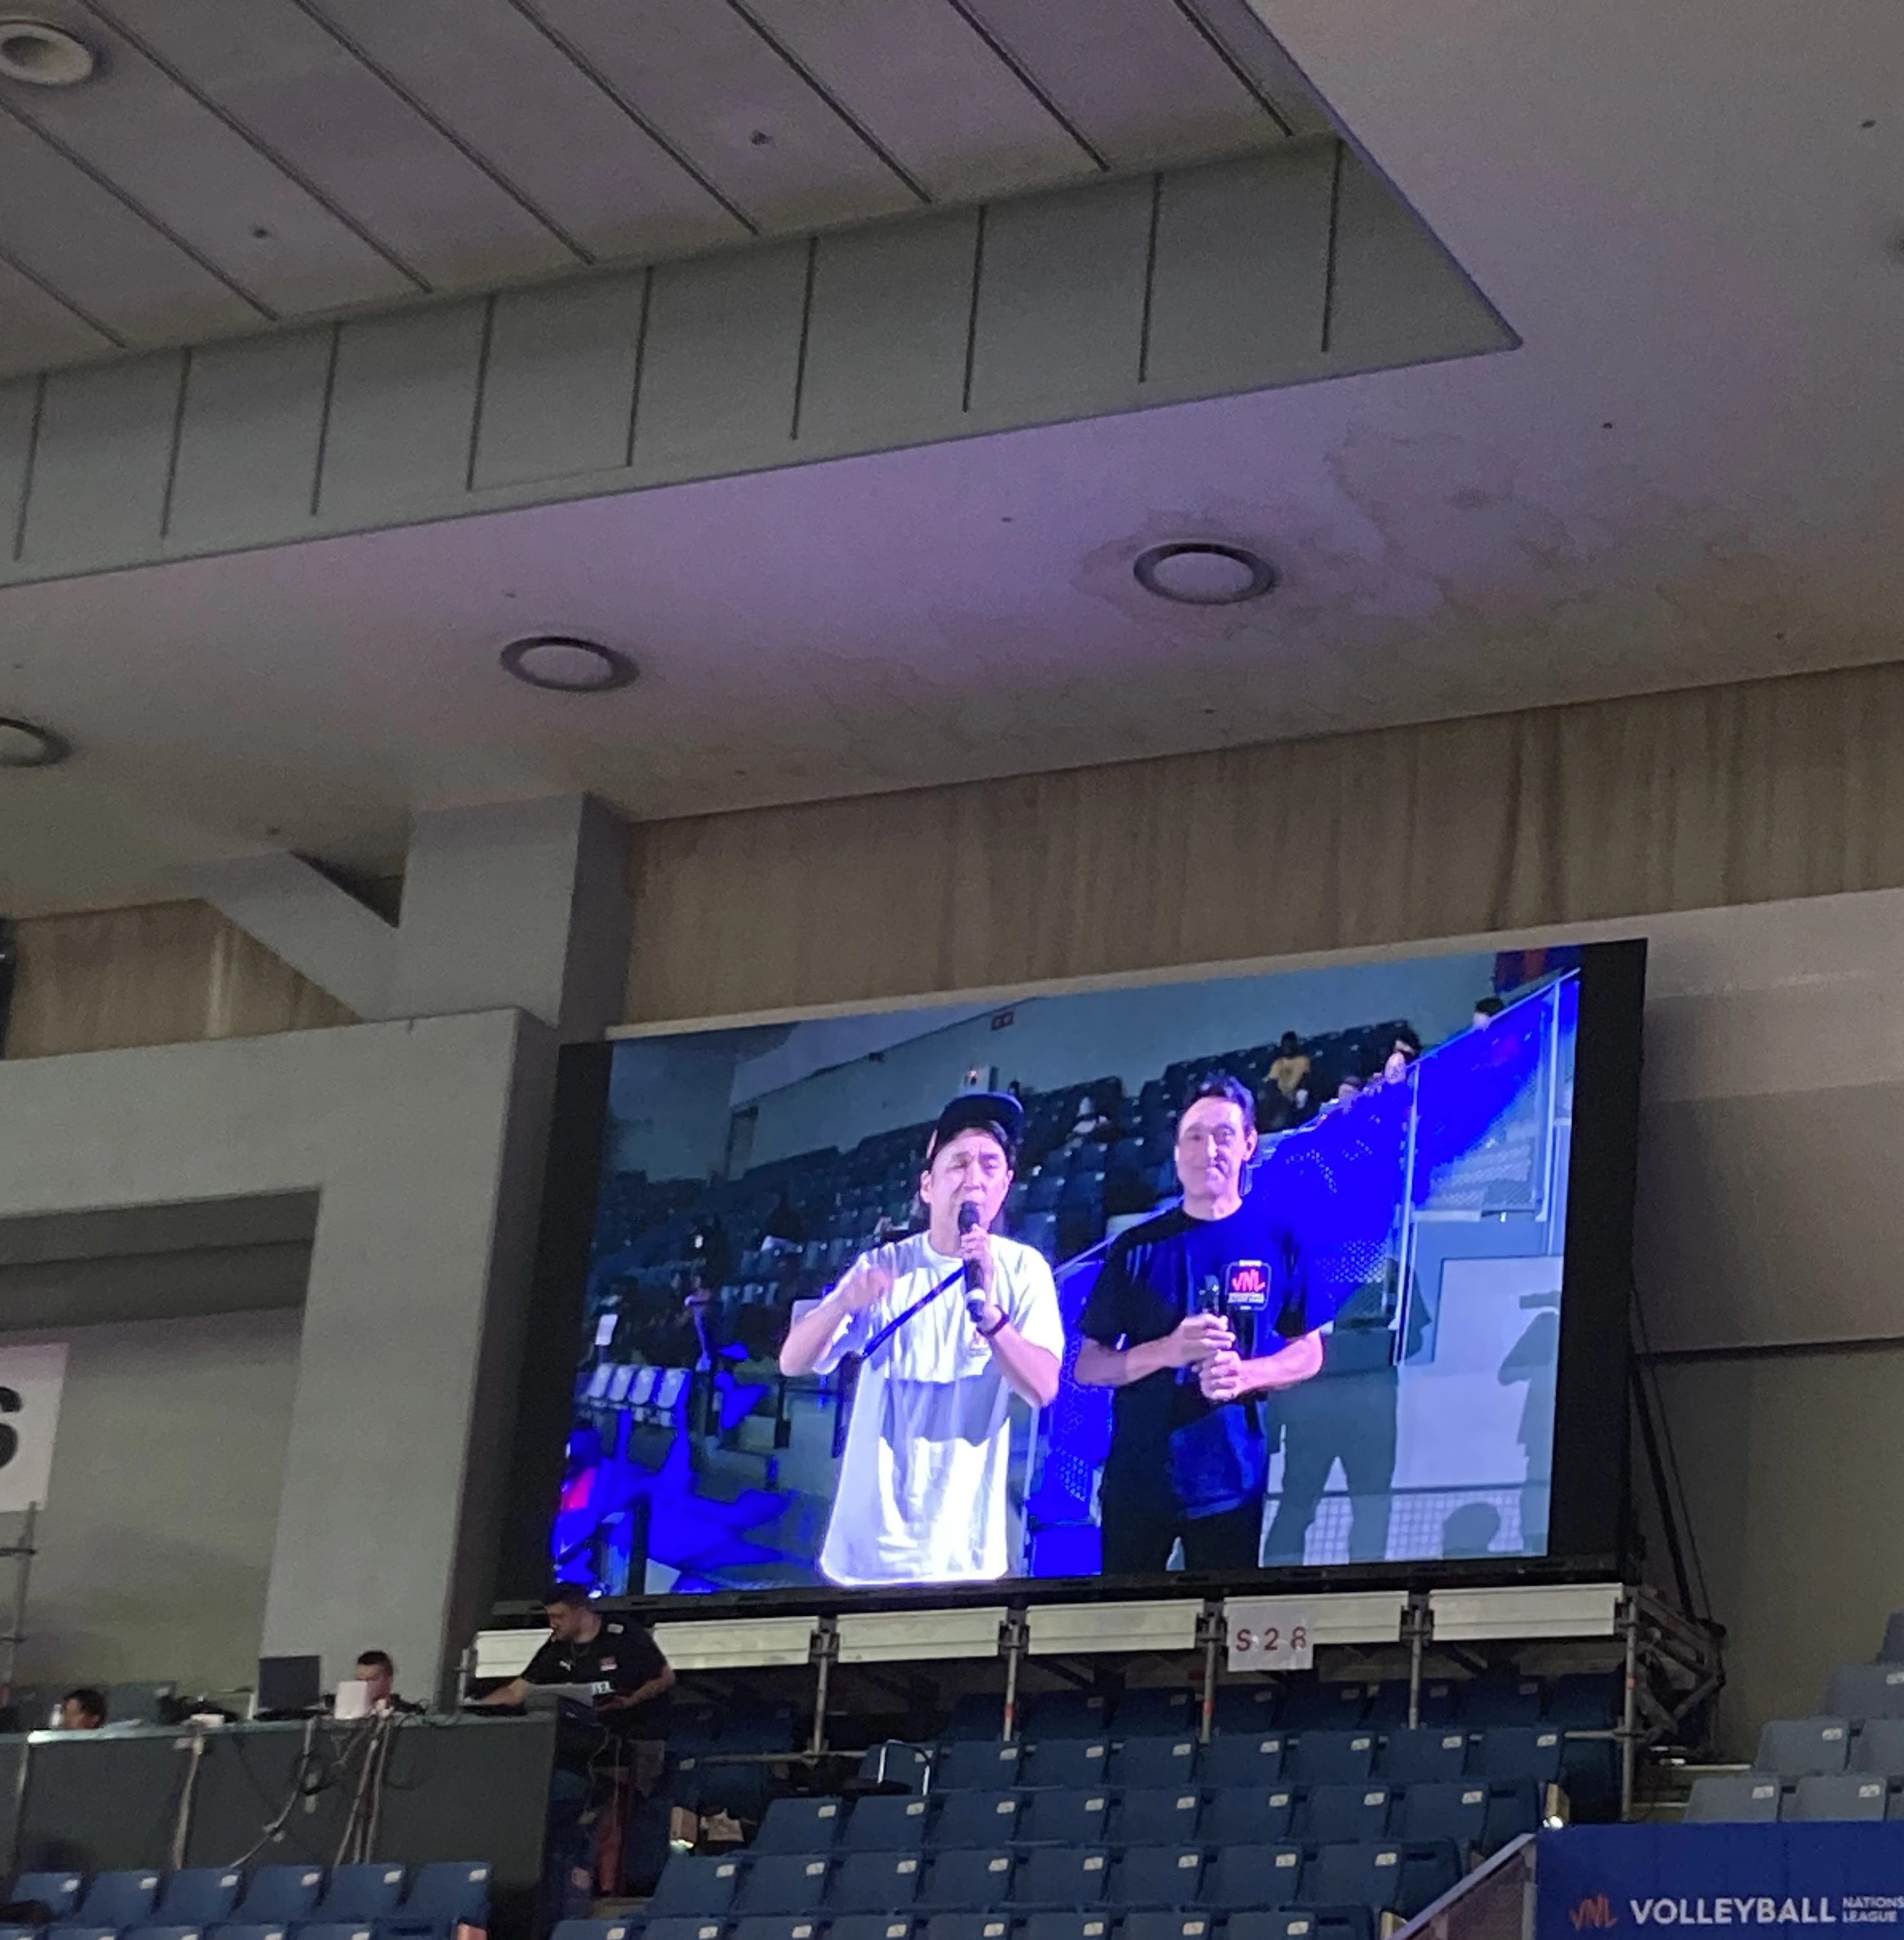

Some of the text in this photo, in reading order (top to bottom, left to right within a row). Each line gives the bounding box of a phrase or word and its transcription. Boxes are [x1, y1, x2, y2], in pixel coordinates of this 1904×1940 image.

[1842, 1896, 1904, 1909] NATIONS
[1629, 1897, 1837, 1924] VOLLEYBALL
[1842, 1910, 1897, 1922] LEAGUE
